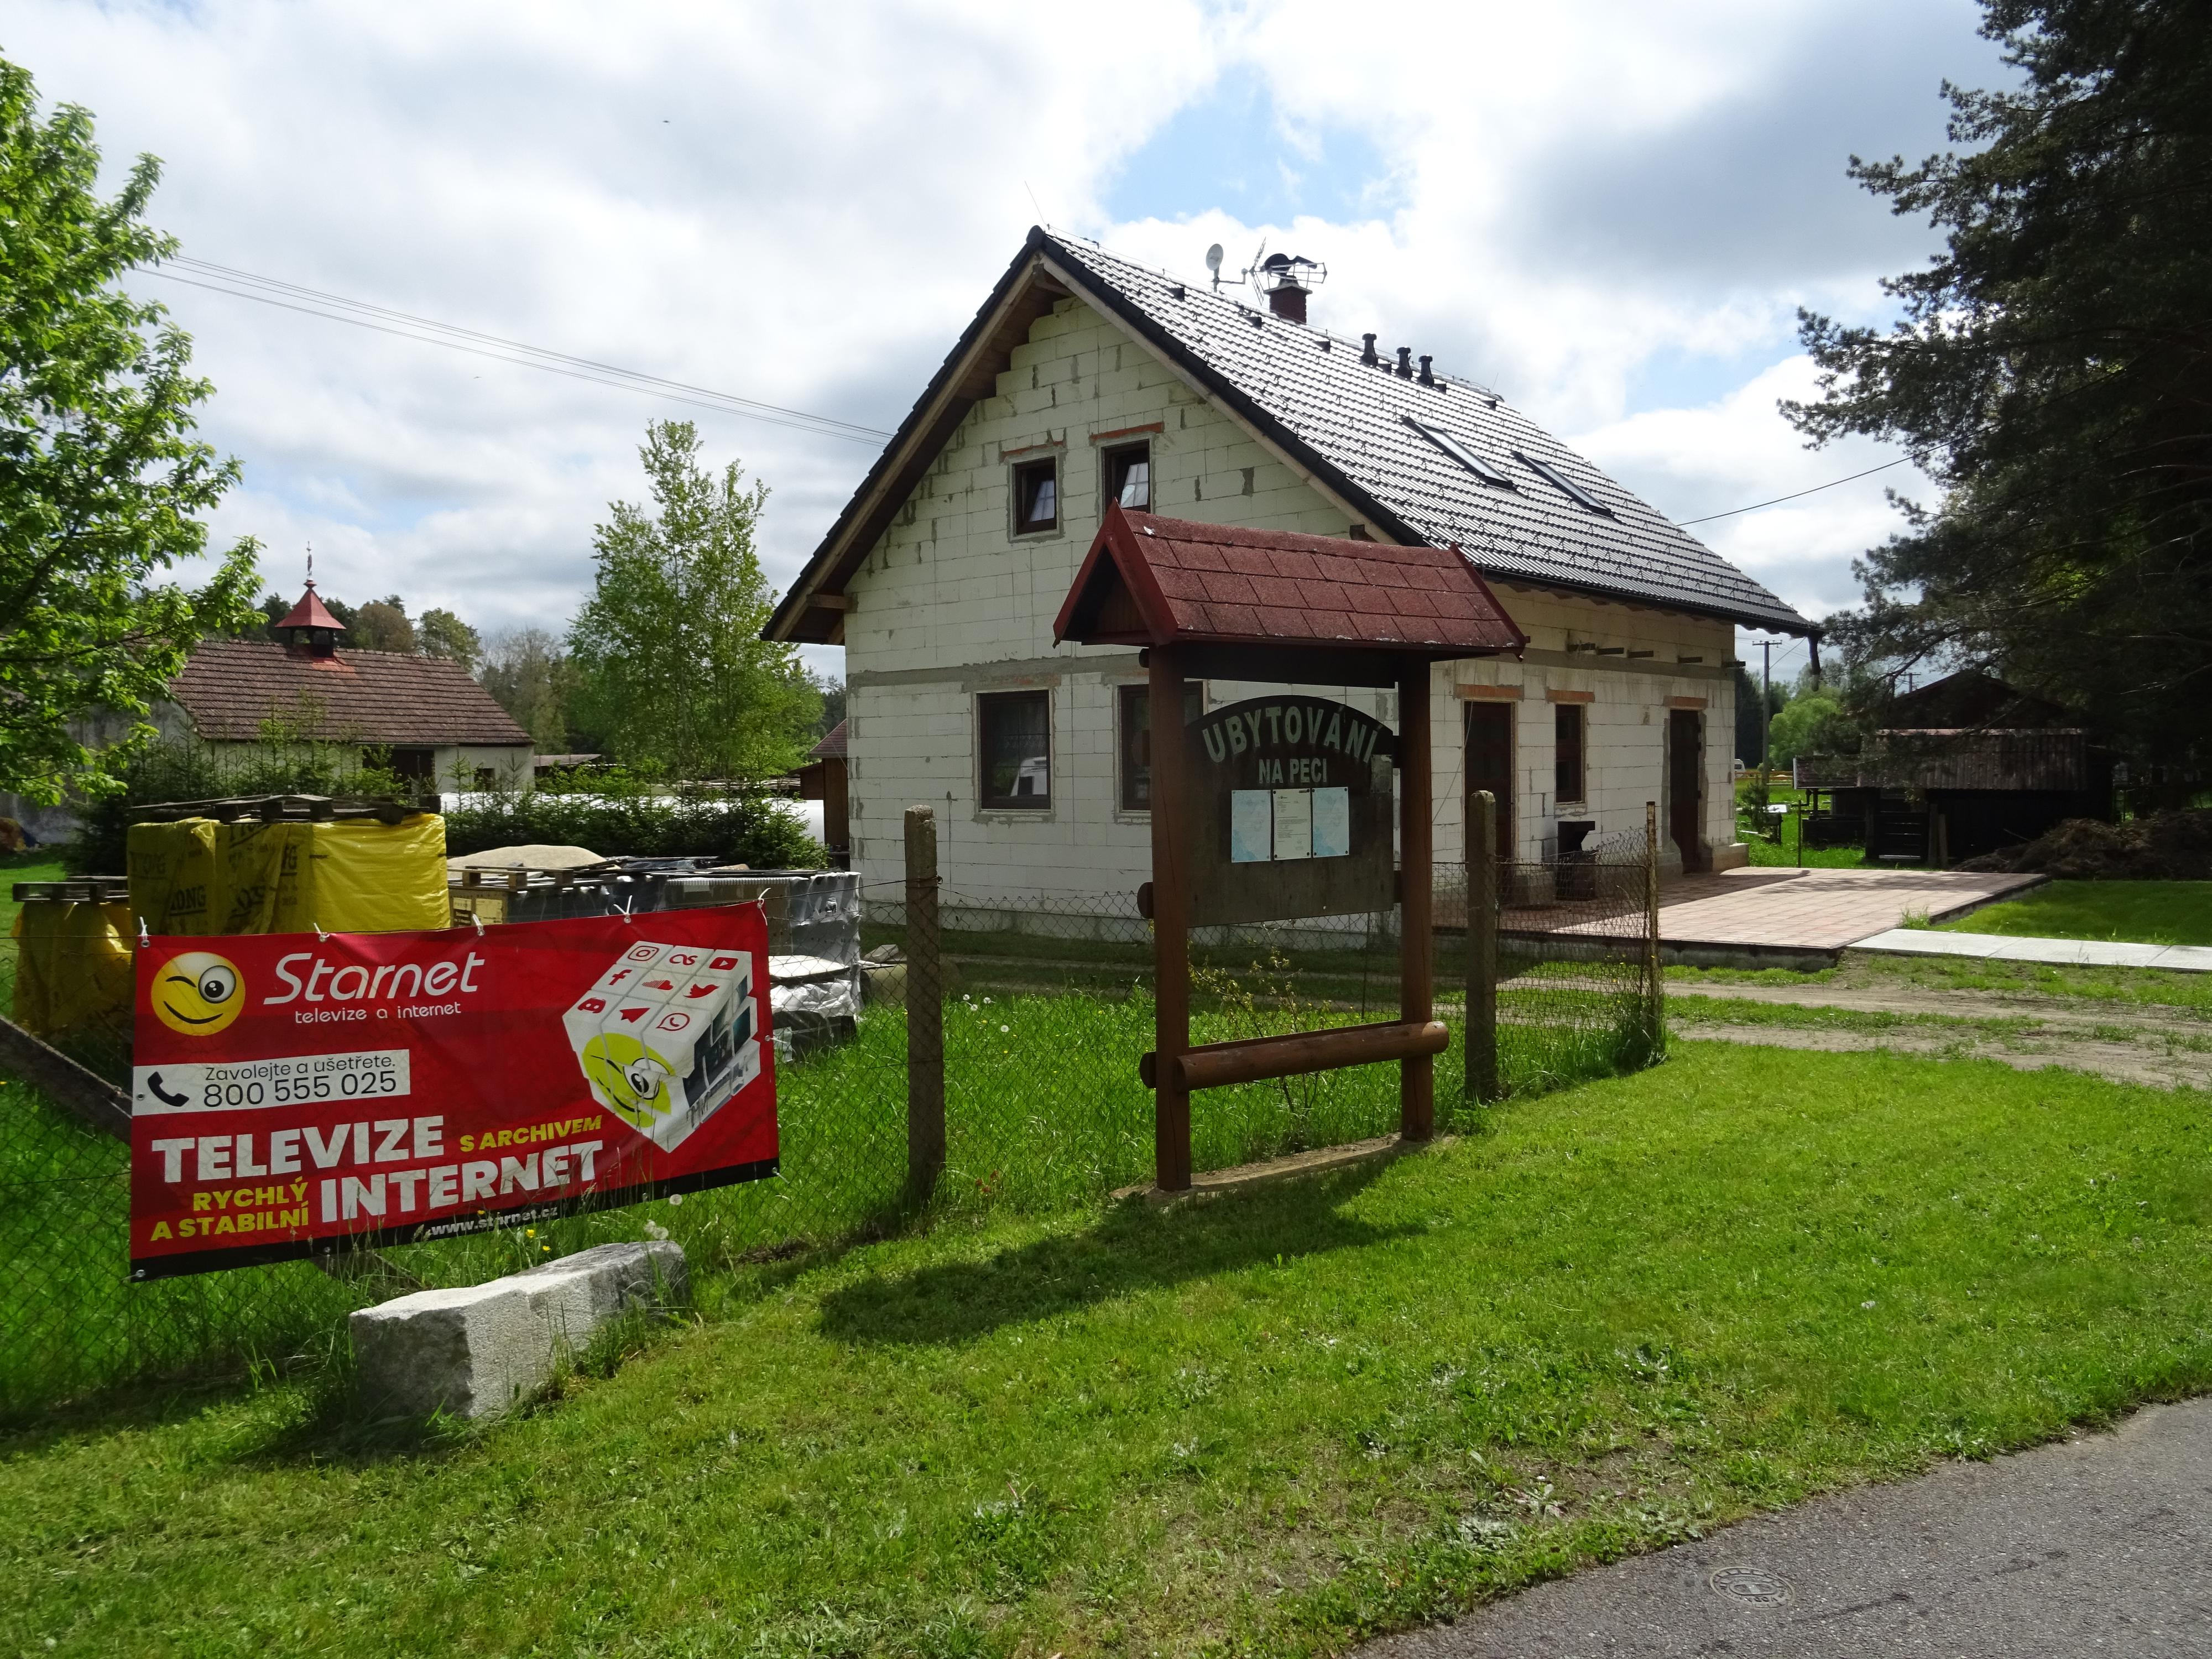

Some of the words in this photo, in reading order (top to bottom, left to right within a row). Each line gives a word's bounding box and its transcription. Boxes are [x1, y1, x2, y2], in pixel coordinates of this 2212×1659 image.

[1202, 705, 1383, 763] UBYTOVÁNÍ
[1259, 759, 1284, 784] NA
[1290, 758, 1327, 784] PECI
[263, 952, 484, 1005] Starnet
[295, 1009, 367, 1024] televize
[377, 1008, 388, 1018] a
[397, 1001, 461, 1018] internet
[205, 1063, 290, 1081] Zavolejte
[296, 1063, 309, 1073] a
[314, 1055, 395, 1072] ušetřete.
[204, 1082, 264, 1107] 800
[275, 1076, 330, 1101] 555
[341, 1071, 396, 1095] 025
[152, 1115, 444, 1182] TELEVIZE
[460, 1135, 474, 1152] S
[479, 1115, 602, 1149] ARCHIVEM
[193, 1177, 308, 1211] RYCHLÝ
[321, 1140, 603, 1223] INTERNET
[150, 1220, 172, 1241] A
[179, 1201, 309, 1239] STABILNÍ
